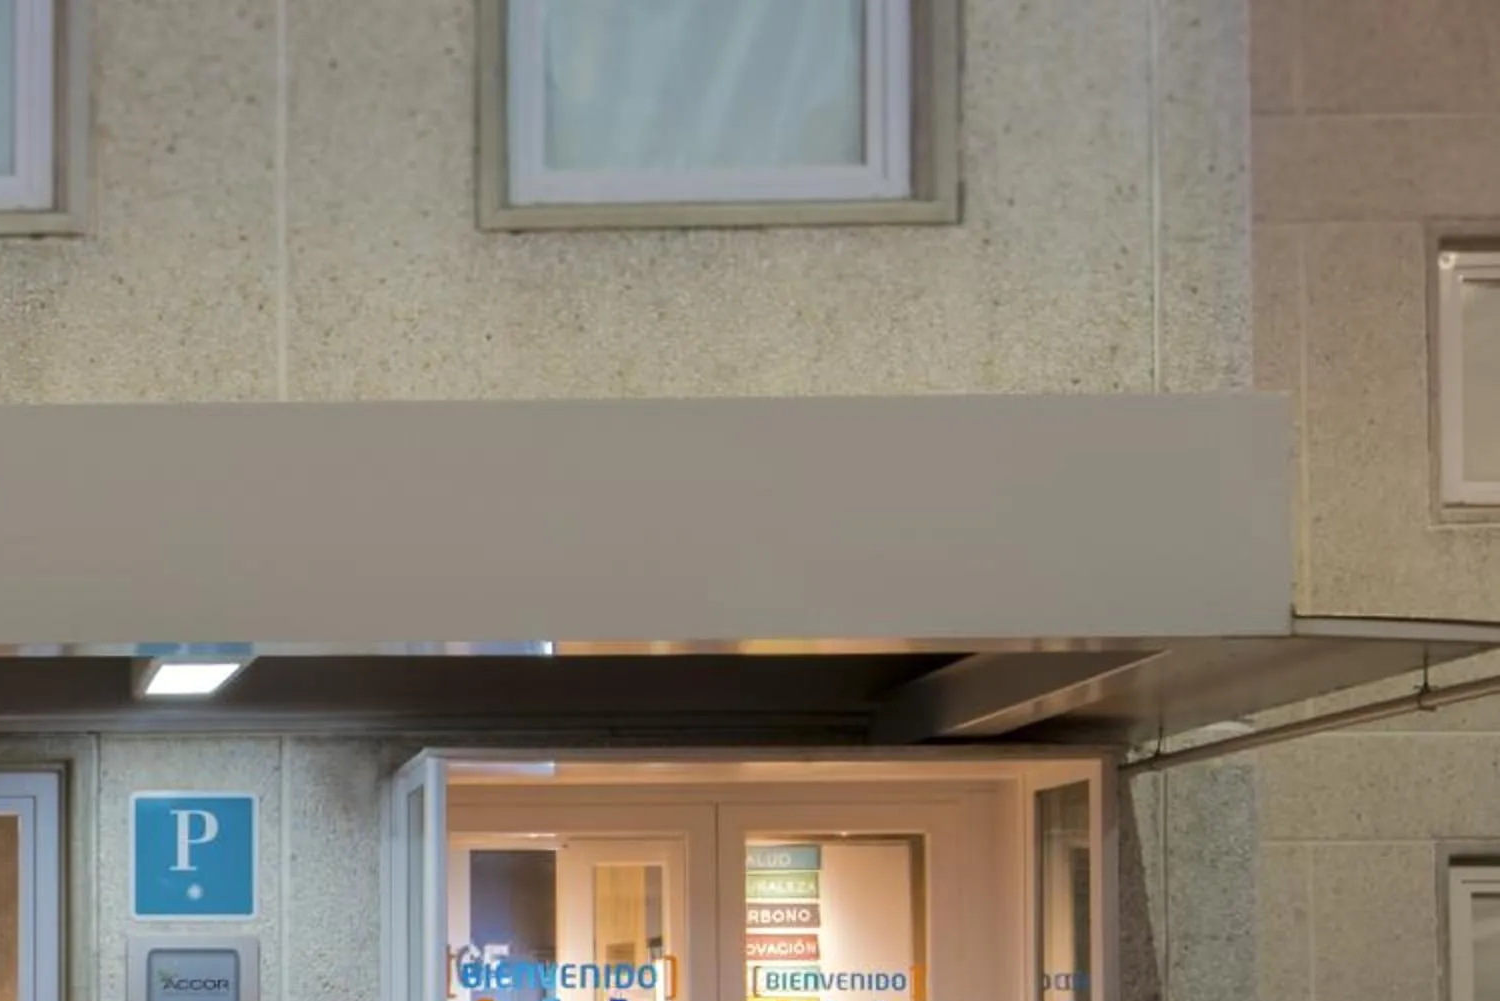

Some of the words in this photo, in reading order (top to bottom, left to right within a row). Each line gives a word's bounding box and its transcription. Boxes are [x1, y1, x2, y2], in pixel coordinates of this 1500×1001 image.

[169, 809, 219, 871] P
[162, 976, 230, 991] ACCOR
[460, 961, 658, 989] BIENVENIDO
[766, 972, 907, 991] BIENVENIDO
